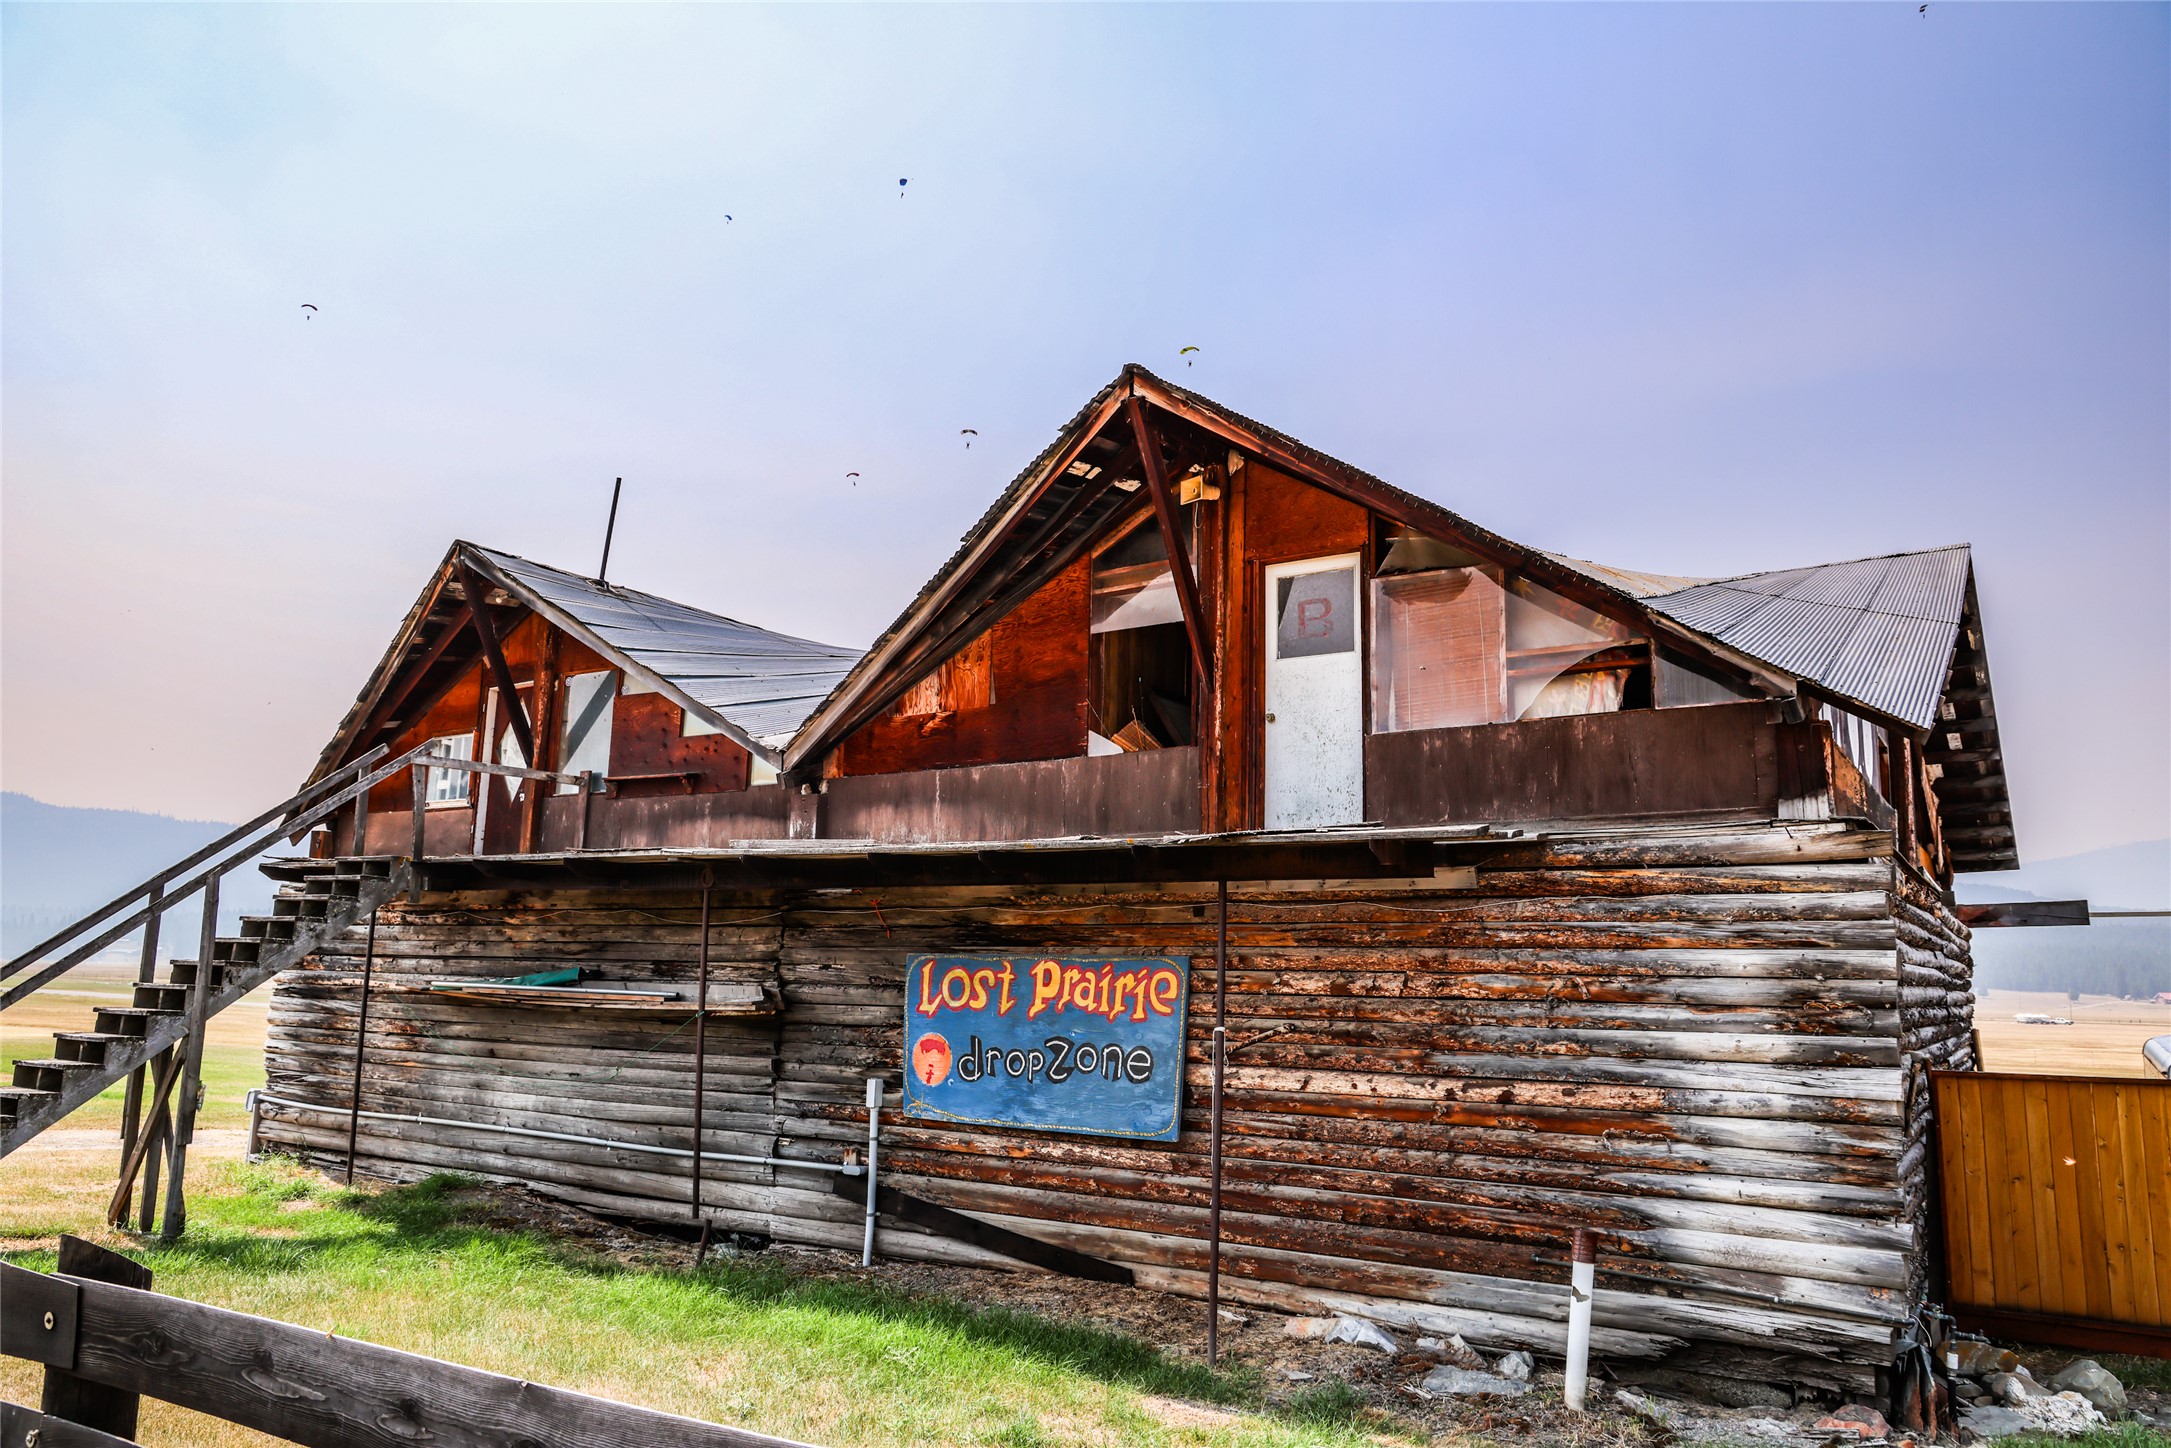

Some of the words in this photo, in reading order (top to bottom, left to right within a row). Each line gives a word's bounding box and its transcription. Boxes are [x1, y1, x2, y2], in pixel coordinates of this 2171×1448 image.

[1298, 598, 1334, 639] B
[916, 959, 1018, 1018] Lost
[1027, 959, 1181, 1023] Prairie
